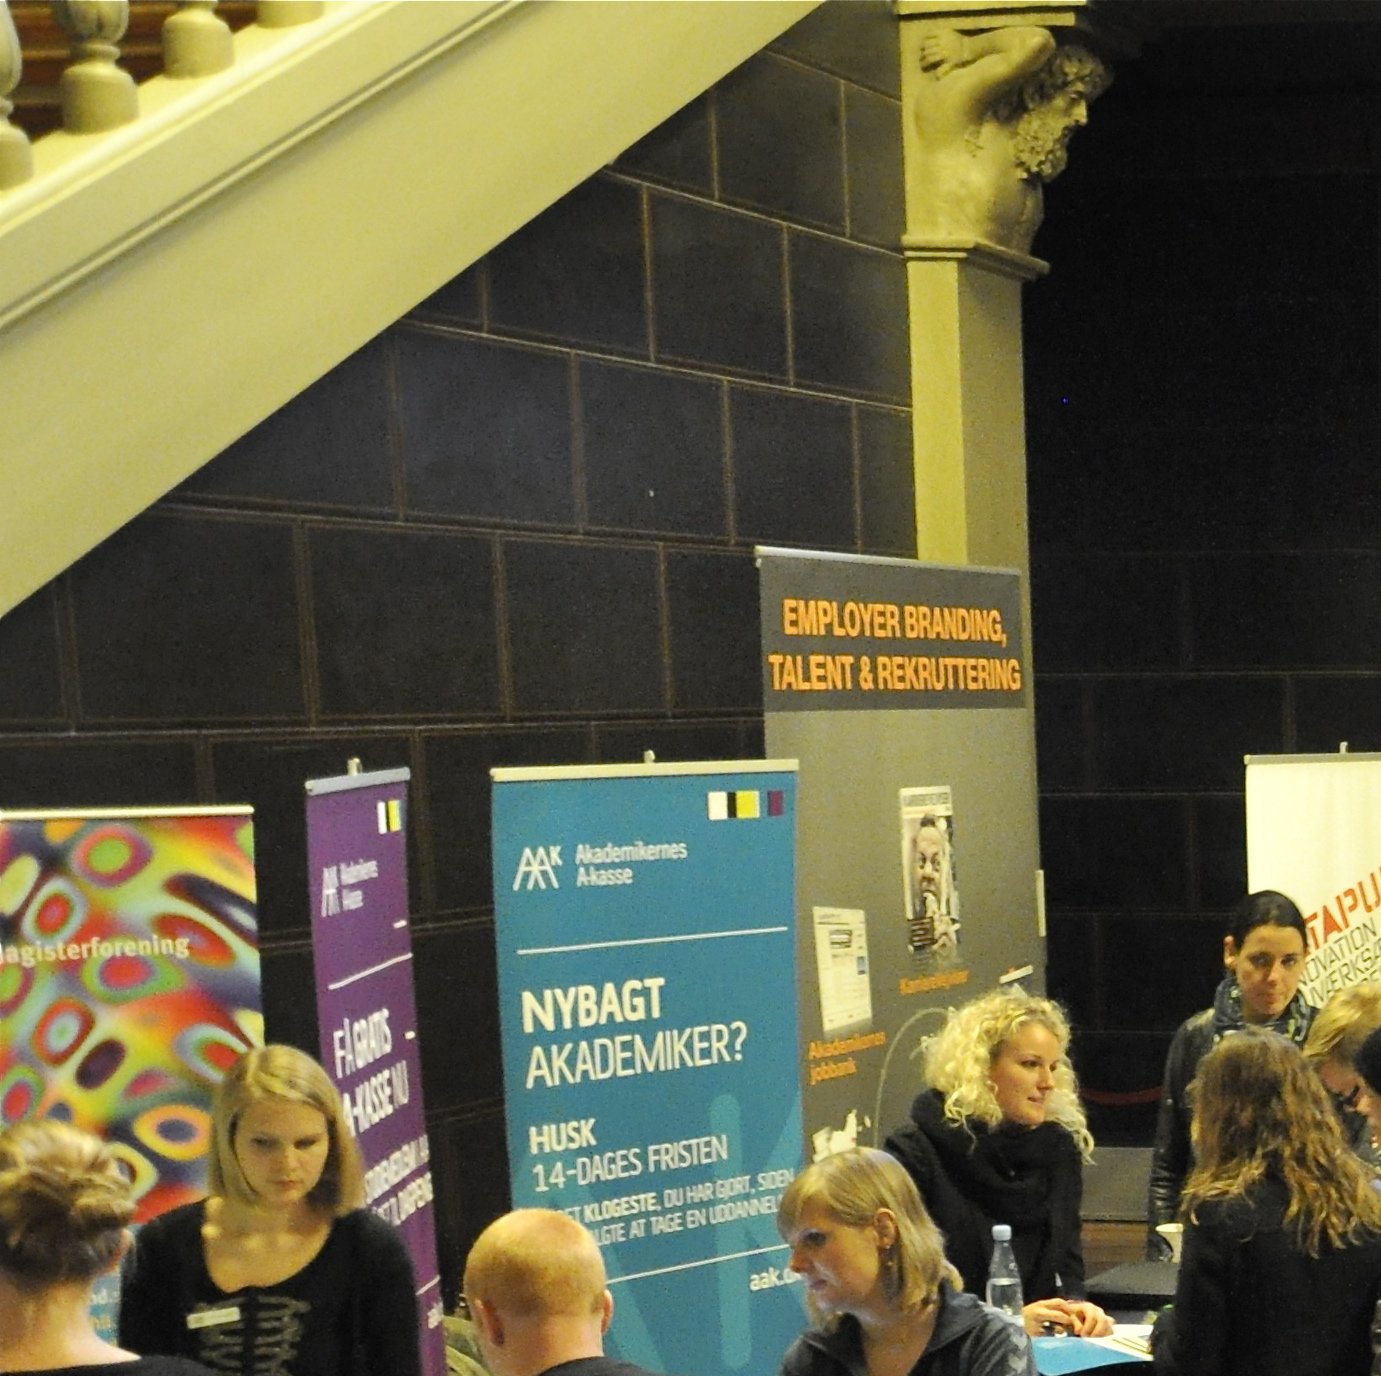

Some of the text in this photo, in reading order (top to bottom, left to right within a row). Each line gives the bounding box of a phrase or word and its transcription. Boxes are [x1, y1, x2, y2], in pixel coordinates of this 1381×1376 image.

[783, 598, 1007, 648] EMPLOYER BRANDING,
[768, 654, 1021, 690] TALENT & REKRUTTERING
[575, 841, 688, 864] Akademikernes
[577, 867, 633, 887] A-kasse
[521, 977, 665, 1033] NYBAGT
[525, 1020, 748, 1089] AKADEMIKER?
[529, 1117, 597, 1154] HUSK
[532, 1134, 729, 1192] 14-DAGES FRISTEN
[584, 1192, 661, 1223] KLOGESTE,
[663, 1187, 684, 1207] DU
[684, 1182, 714, 1203] HAR
[649, 1213, 684, 1235] TAGE
